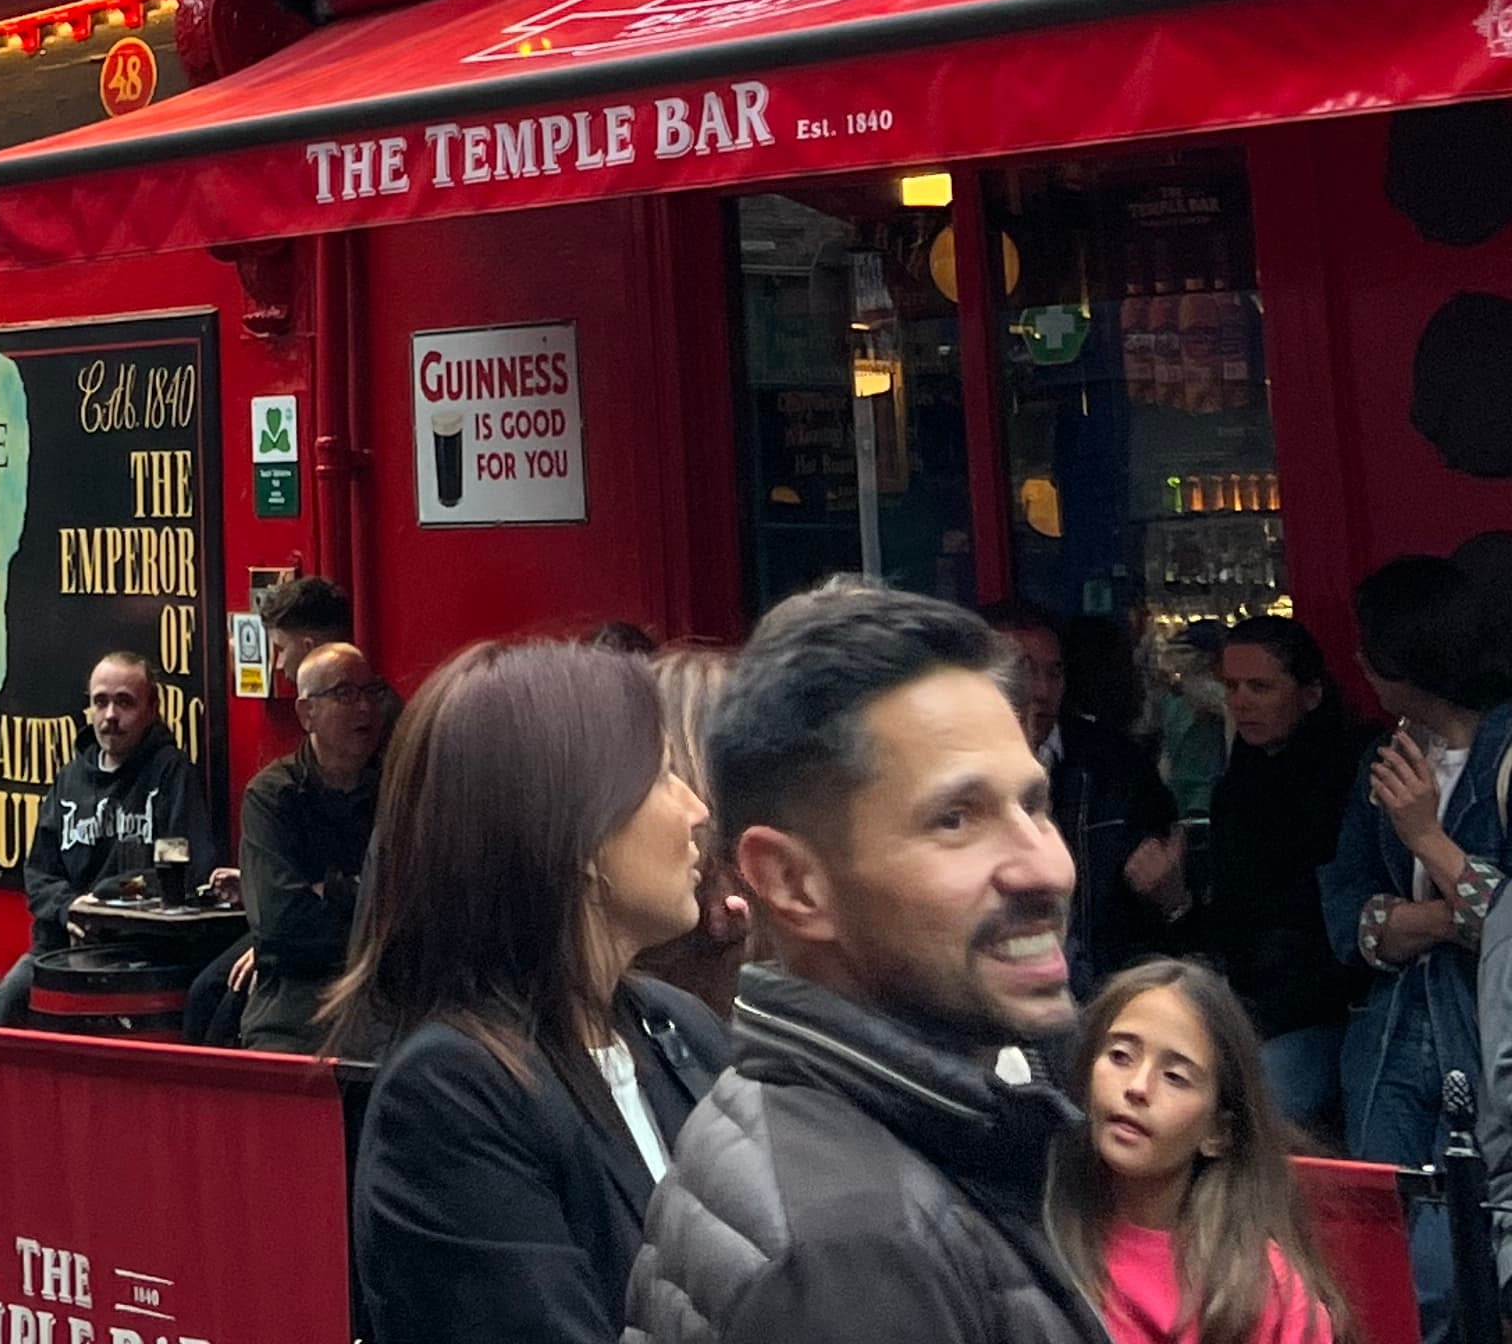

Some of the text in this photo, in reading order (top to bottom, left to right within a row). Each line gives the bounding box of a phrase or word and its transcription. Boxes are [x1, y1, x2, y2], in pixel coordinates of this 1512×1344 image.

[108, 55, 143, 104] 48
[306, 79, 894, 205] THE TEMPLE BAR Est. 1840
[144, 363, 195, 429] 1840
[420, 350, 569, 403] GUINNESS
[474, 408, 566, 441] IS GOOD
[130, 450, 194, 518] THE
[476, 449, 569, 481] FOR YOU
[58, 526, 198, 598] EMPEROR
[160, 604, 195, 675] OF
[15, 1236, 93, 1309] THE
[132, 1285, 161, 1307] 1840
